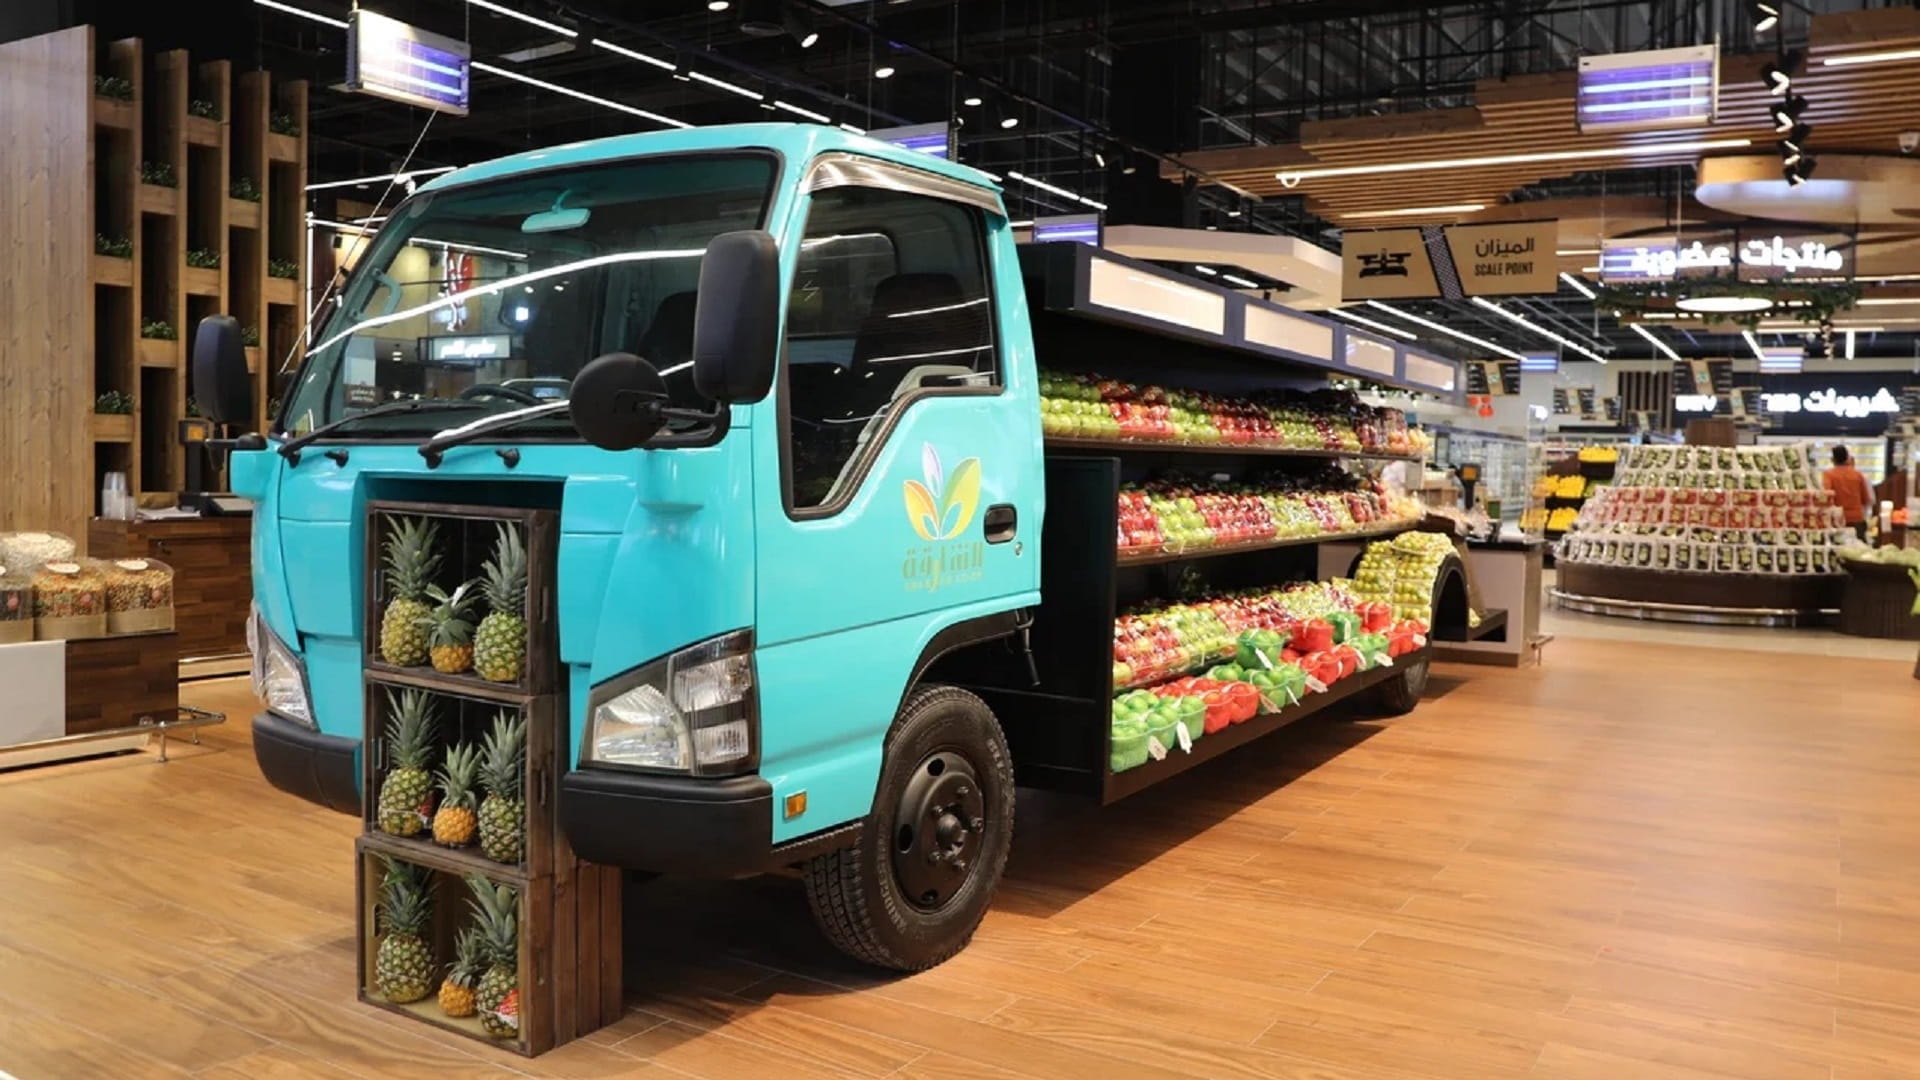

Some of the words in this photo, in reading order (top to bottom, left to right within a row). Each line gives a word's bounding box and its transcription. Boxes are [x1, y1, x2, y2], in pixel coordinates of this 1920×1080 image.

[1475, 237, 1535, 257] الميزان
[1474, 263, 1503, 276] SCALE
[1505, 262, 1534, 275] POINT
[1803, 388, 1899, 417] شروبات
